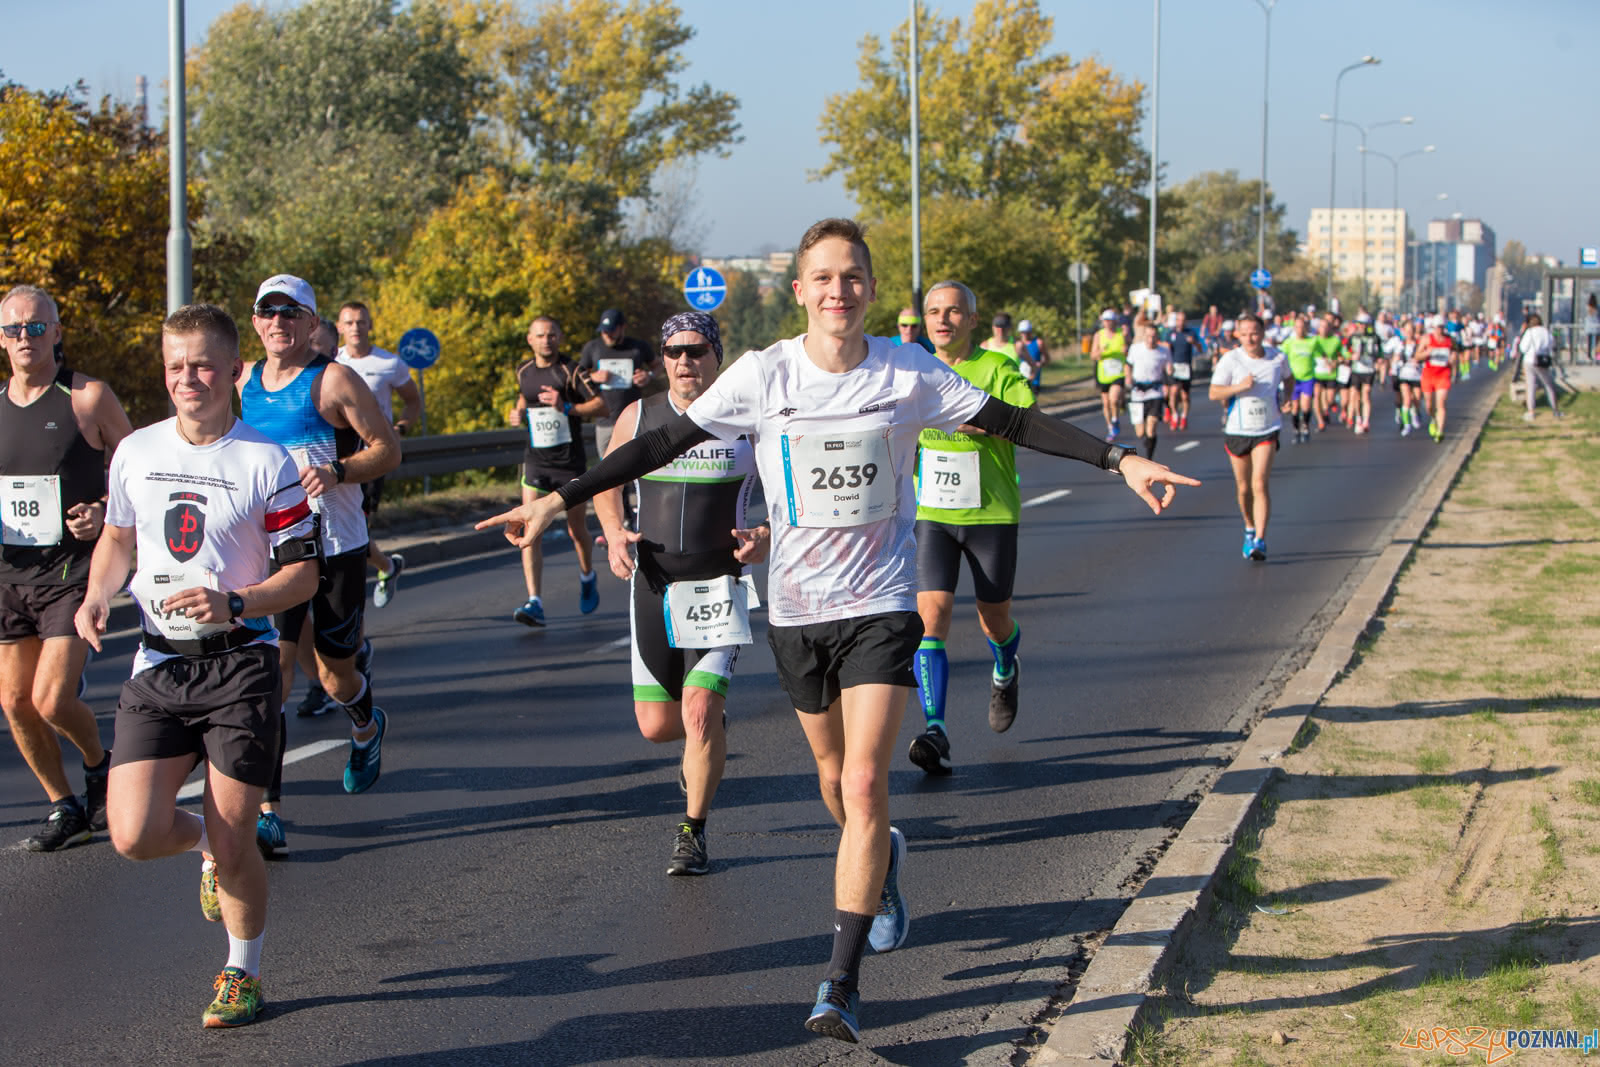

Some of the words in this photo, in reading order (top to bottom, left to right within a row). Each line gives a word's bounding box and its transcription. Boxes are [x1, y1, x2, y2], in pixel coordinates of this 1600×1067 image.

[779, 407, 798, 417] 4F
[536, 419, 561, 432] 5100
[810, 462, 878, 490] 2639
[934, 471, 961, 486] 778
[833, 493, 860, 502] Dawid
[11, 500, 40, 517] 188
[686, 599, 734, 622] 4597
[168, 624, 192, 632] Maciej
